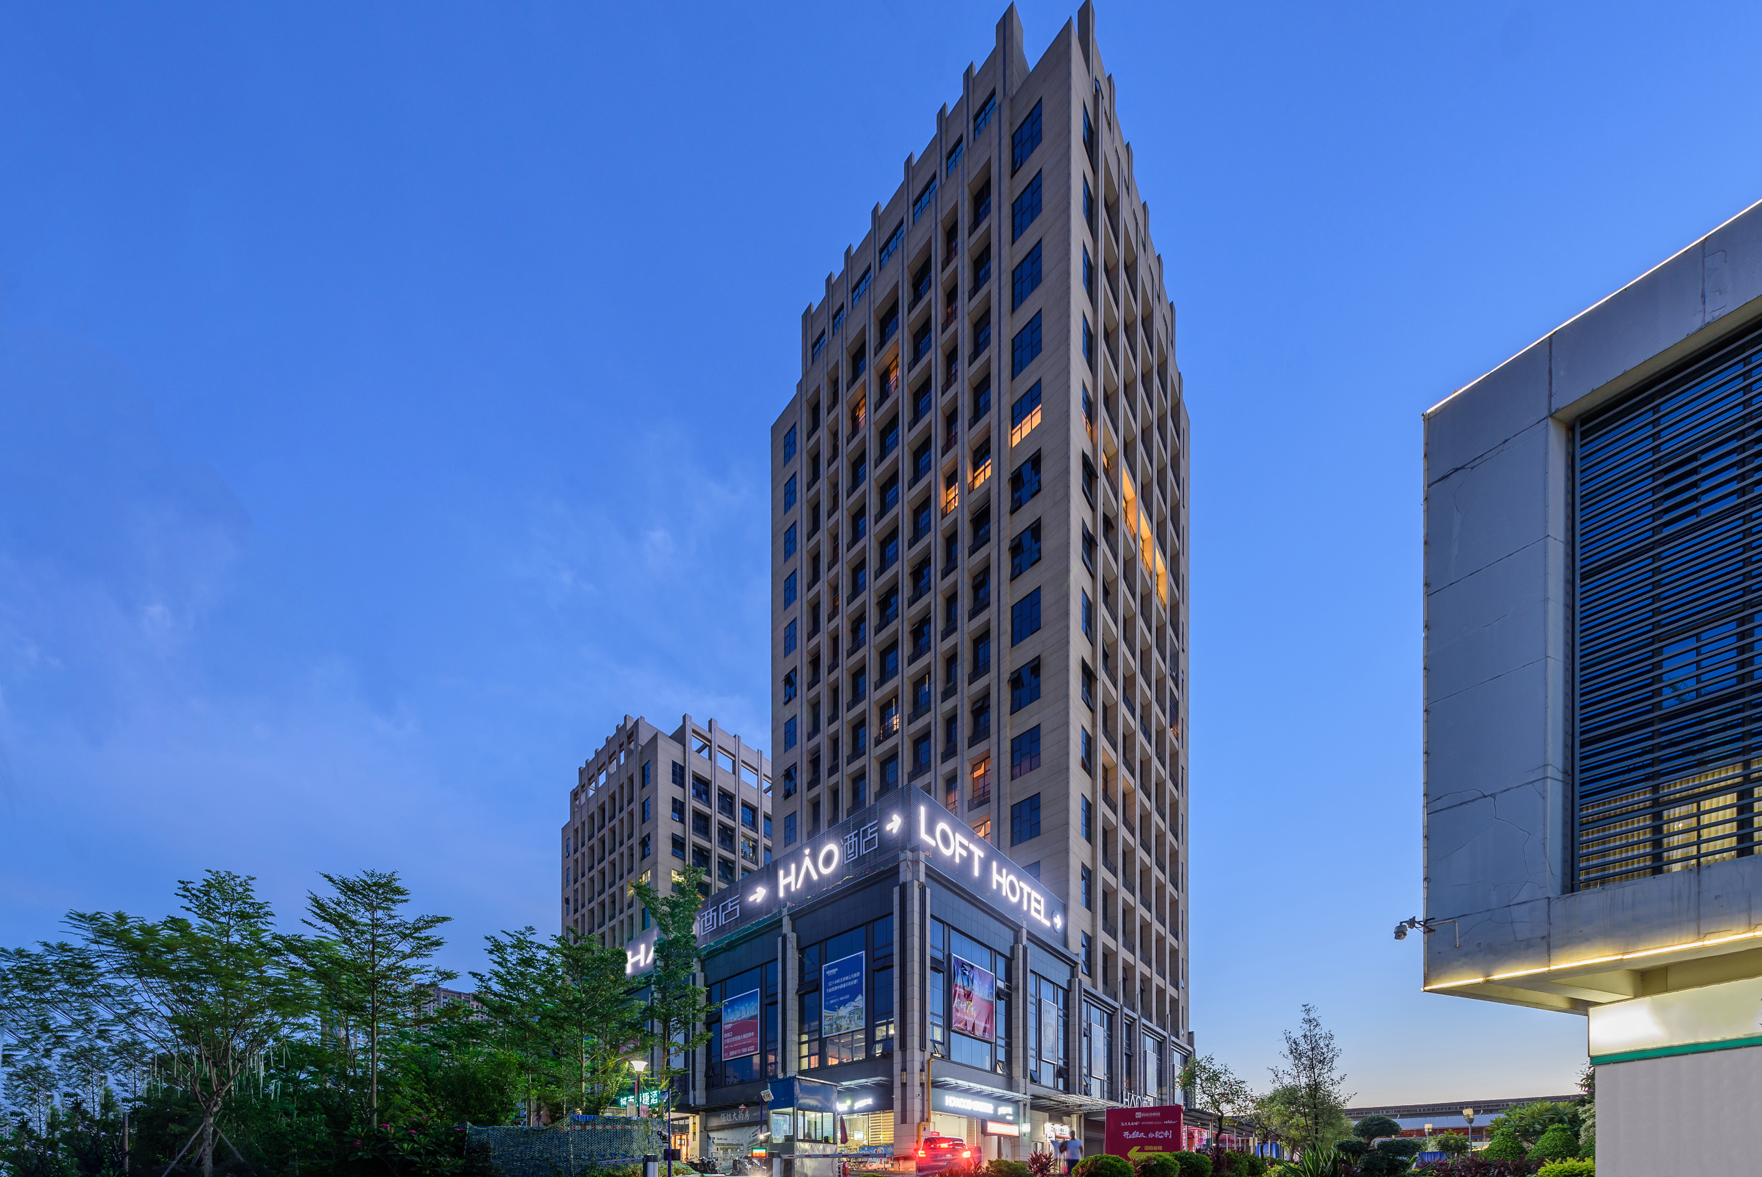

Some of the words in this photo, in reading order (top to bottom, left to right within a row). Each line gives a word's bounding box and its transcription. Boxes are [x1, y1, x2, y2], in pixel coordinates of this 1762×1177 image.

[840, 819, 879, 867] 酒店
[920, 806, 984, 877] LOFT
[992, 860, 1051, 927] HOTEL
[697, 894, 740, 936] 酒店
